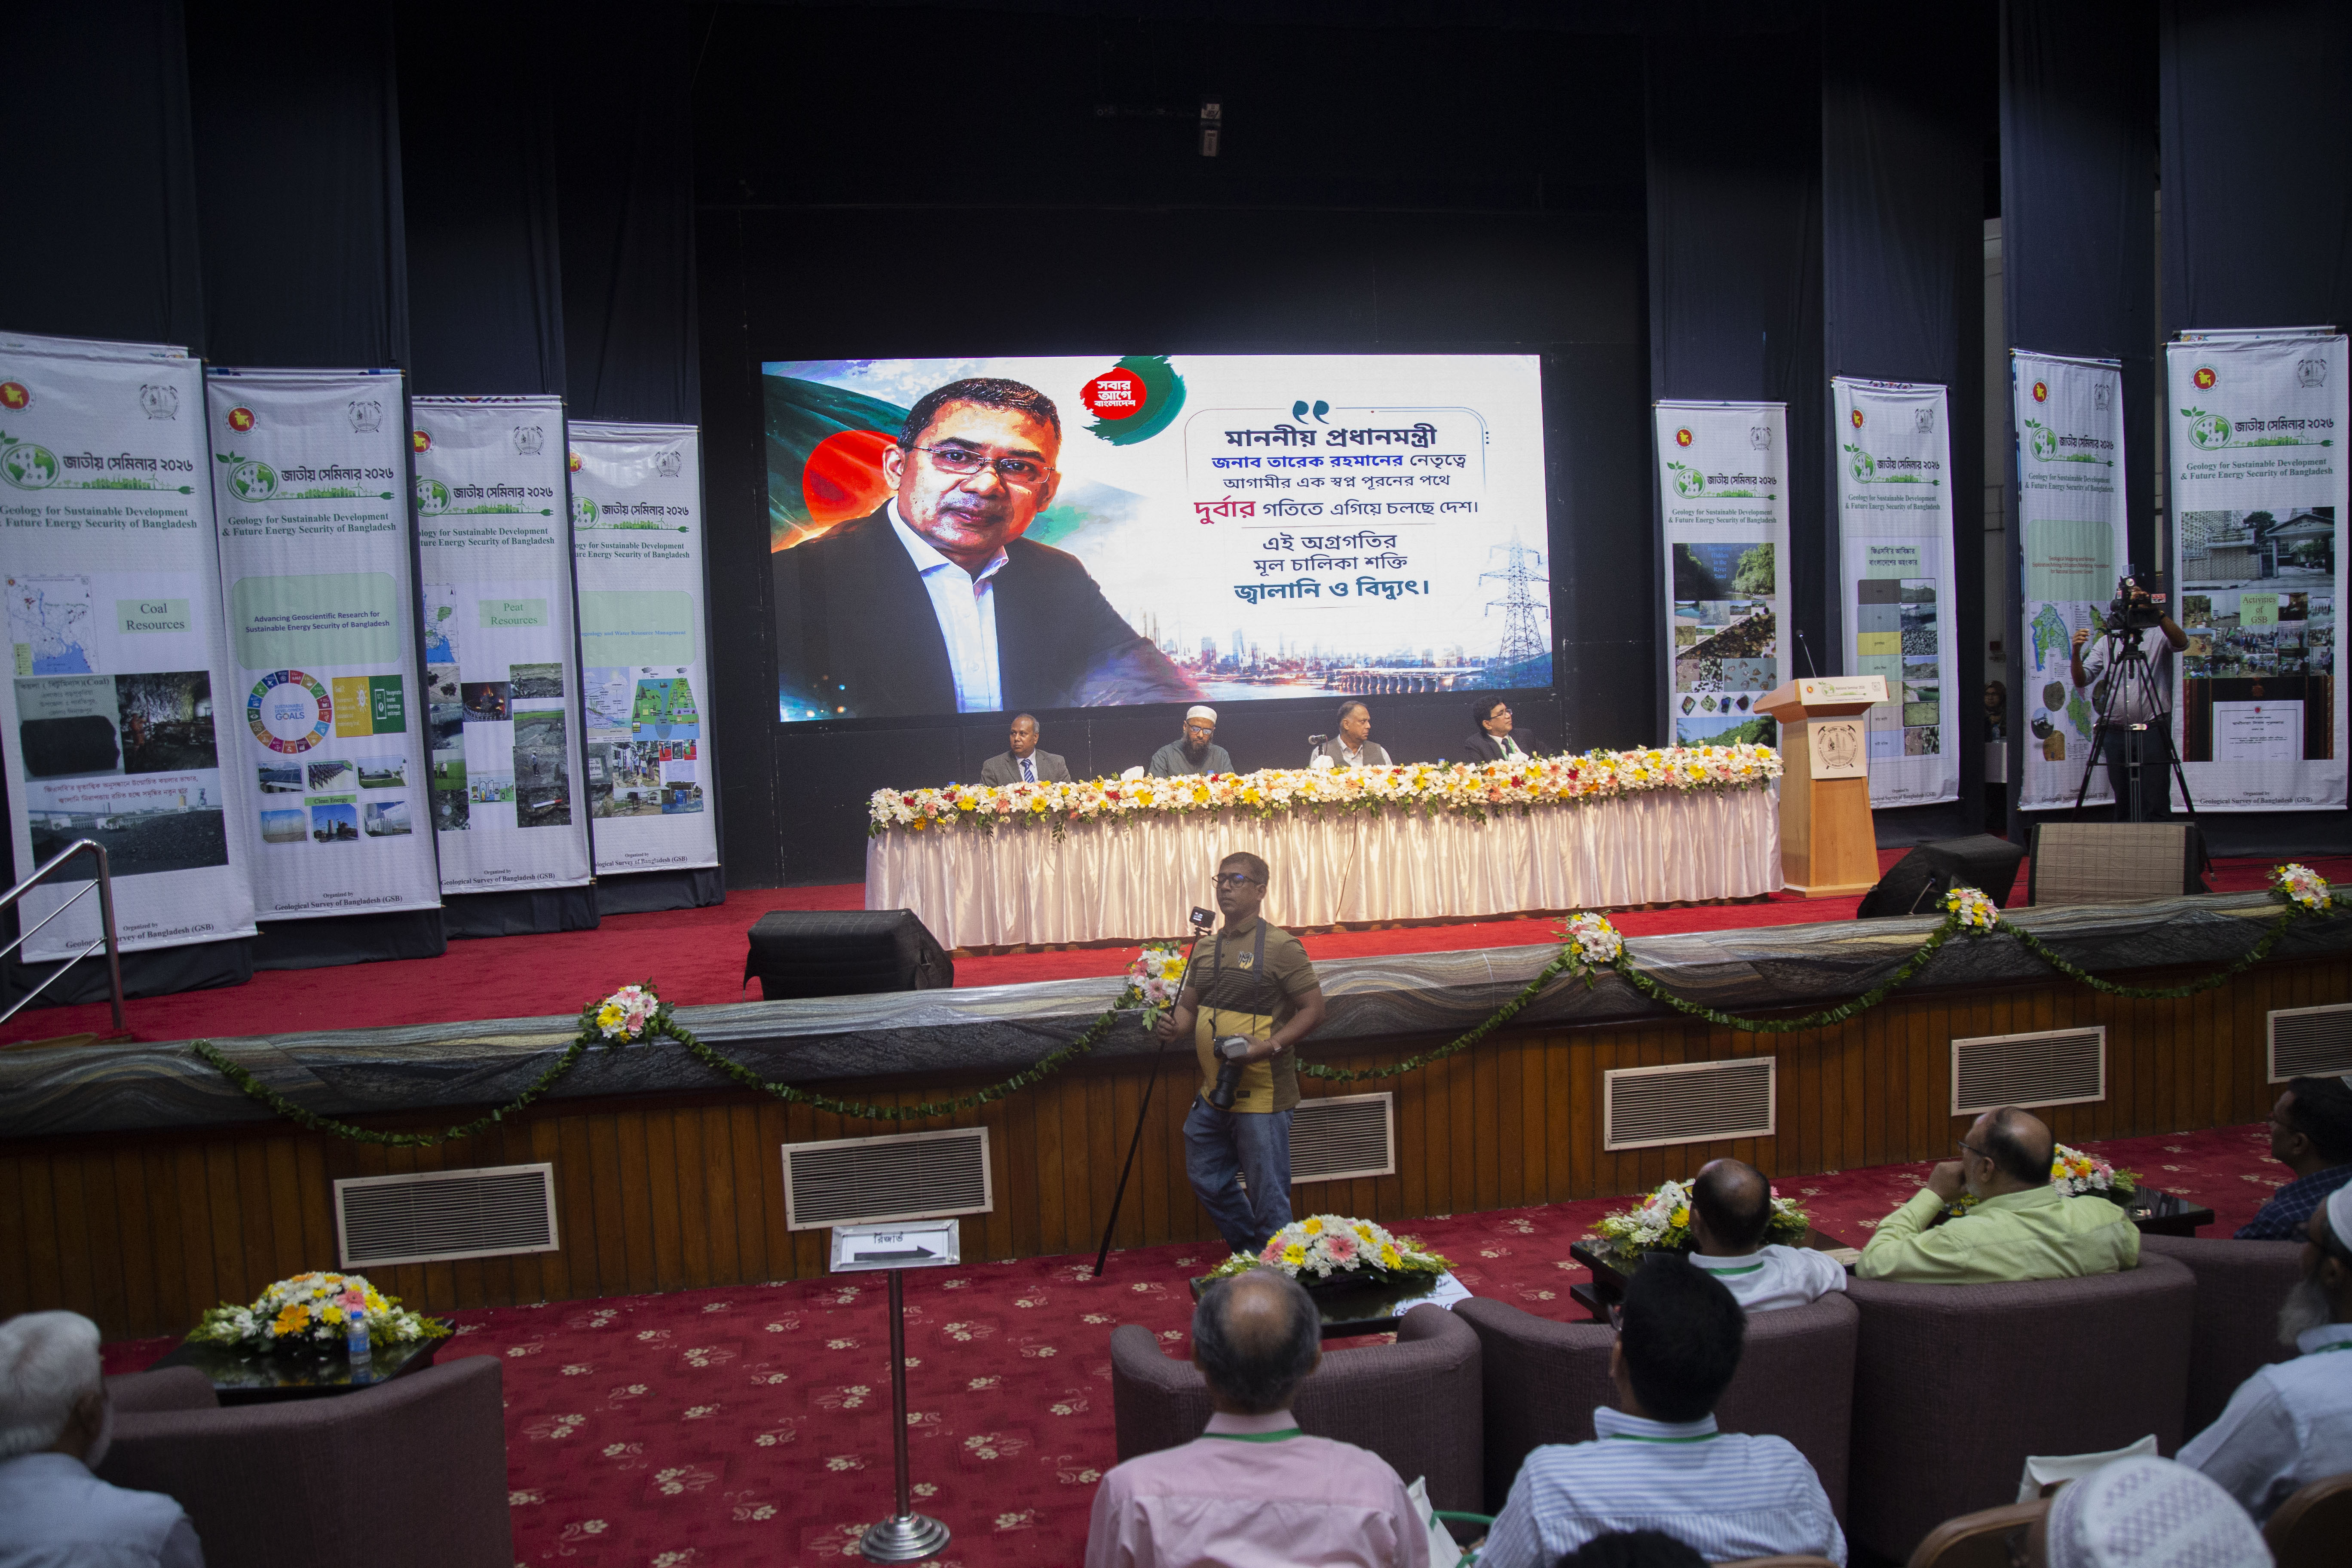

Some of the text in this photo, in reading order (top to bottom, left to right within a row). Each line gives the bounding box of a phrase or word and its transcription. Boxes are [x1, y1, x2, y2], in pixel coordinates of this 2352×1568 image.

[1097, 380, 1131, 390] সবার
[1098, 390, 1131, 400] আগে
[2235, 416, 2334, 432] জাতীয় সেমিনার ২০২৬
[1225, 423, 1437, 448] মাননীয় প্রধানমন্ত্রী
[2059, 434, 2113, 449] জাতীয় সেমিনার ২০২৬
[63, 451, 193, 471] জাতীয় সেমিনার ২০২৬
[1212, 454, 1466, 470] জনাব তারেক রহমানের নেতৃত্বে
[1877, 457, 1896, 470] জাতীয়
[1898, 457, 1921, 470] সেমিনার
[2187, 462, 2217, 471] Geology
[2278, 459, 2326, 467] Development
[281, 465, 394, 482] জাতীয় সেমিনার ২০২৬
[1707, 473, 1777, 485] জাতীয় সেমিনার ২০২৬
[2247, 471, 2278, 479] Security
[2290, 468, 2333, 477] Bangladesh
[1223, 474, 1450, 490] আগামীর এক স্বপ্ন পূরনের পথে
[453, 484, 553, 499] জাতীয় সেমিনার ২০২৬
[0, 505, 188, 518] Geology for Sustainable Development
[602, 502, 689, 516] জাতীয় সেমিনার ২০২৬
[1194, 495, 1478, 524] দুর্বার গতিতে এগিয়ে চলছে দেশ।
[6, 518, 197, 530] Future Energy Security of Bangladesh
[228, 513, 389, 527] Geology for Sustainable Development
[222, 523, 396, 536] & Future Energy Security of Bangladesh
[453, 528, 497, 536] Sustainable
[499, 528, 548, 536] Development
[468, 539, 499, 547] Security
[511, 537, 554, 545] Bangladesh
[1263, 530, 1397, 551] এই অগ্রগতির
[614, 551, 642, 559] Security
[652, 551, 690, 560] Bangladesh
[1253, 552, 1408, 576] মূল চালিকা শক্তি
[1234, 576, 1429, 605] জ্বালানি ও বিদ্যুৎ।
[141, 603, 167, 614] Coal
[504, 603, 523, 611] Peat
[291, 612, 336, 621] Geoscientific
[491, 616, 538, 625] Resources
[126, 620, 185, 630] Resources
[246, 625, 285, 633] Sustainable
[288, 623, 311, 632] Energy
[312, 622, 340, 630] Security
[351, 620, 389, 628] Bangladesh
[441, 878, 472, 886] Geological
[502, 874, 536, 882] Bangladesh
[343, 897, 381, 906] Bangladesh
[147, 926, 190, 938] Bangladesh
[192, 923, 214, 933] (GSB)
[874, 1231, 903, 1243] রিজার্ভ
